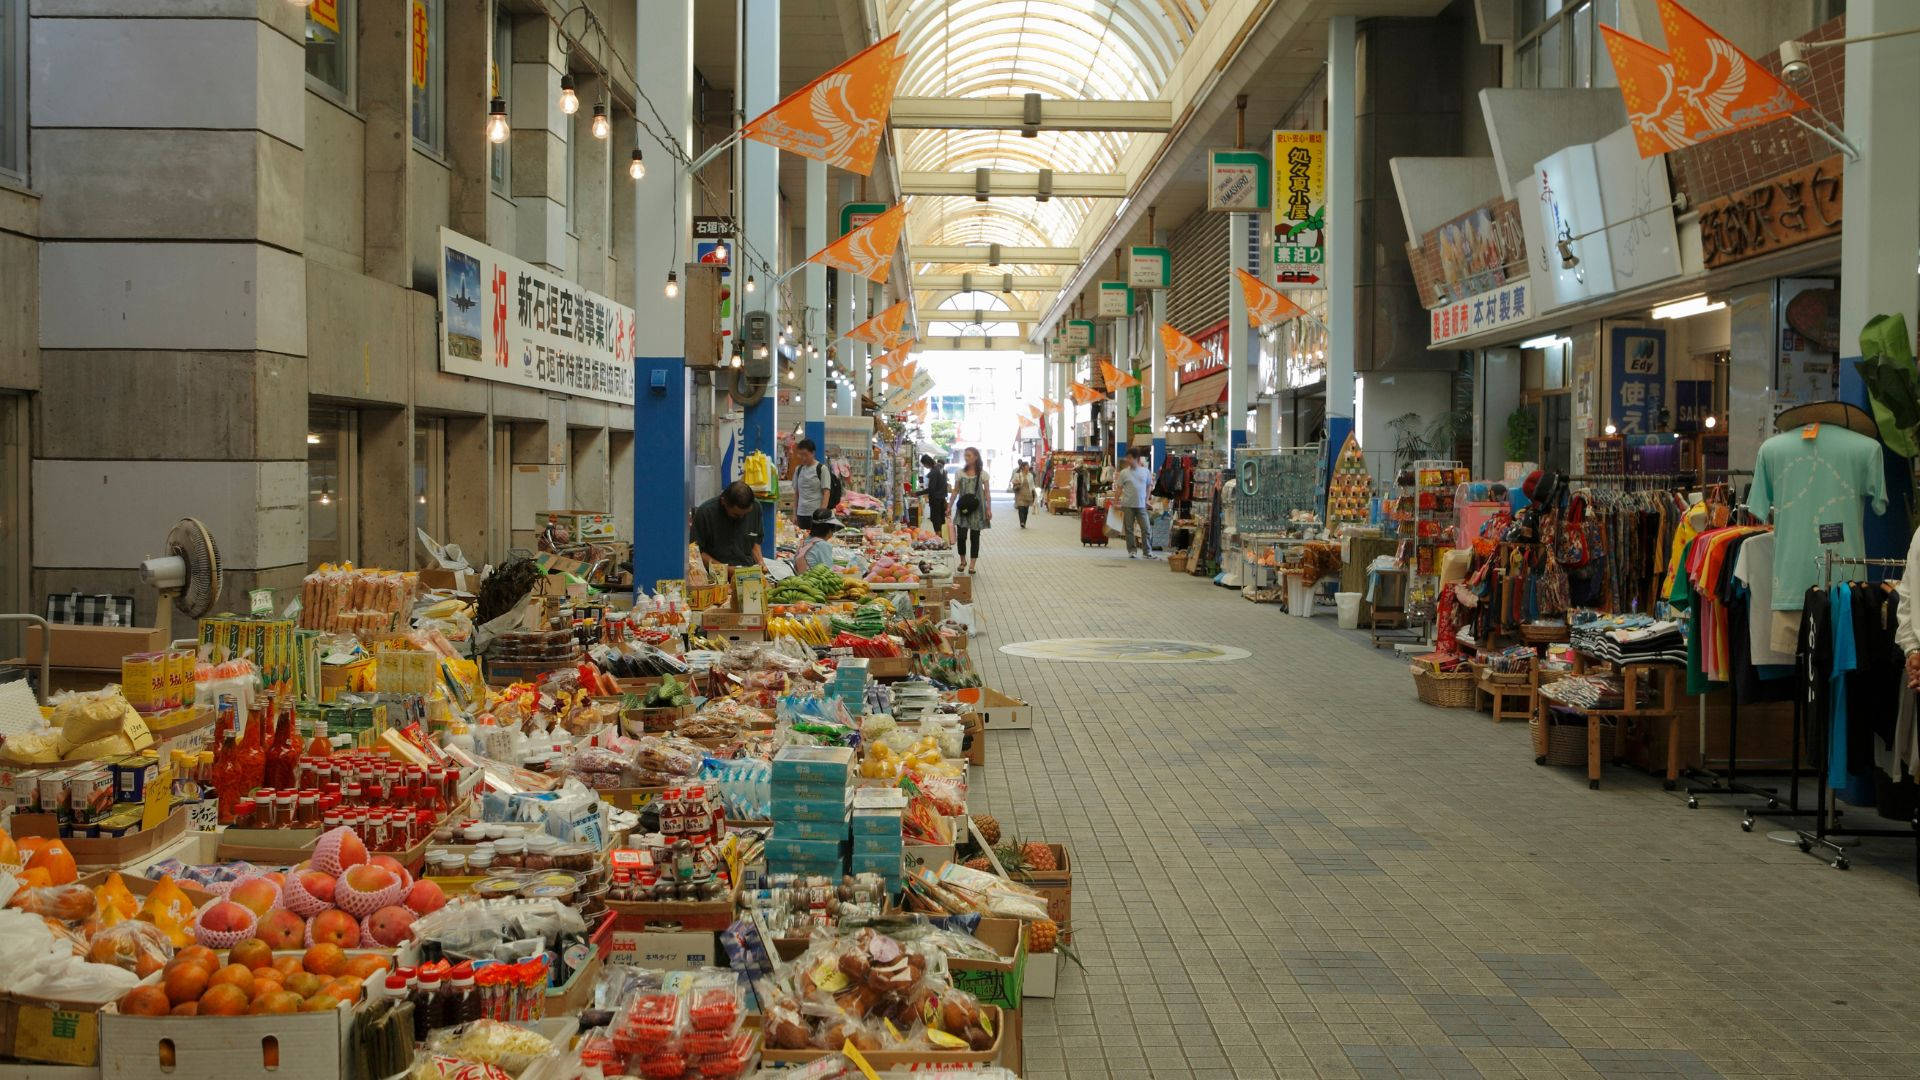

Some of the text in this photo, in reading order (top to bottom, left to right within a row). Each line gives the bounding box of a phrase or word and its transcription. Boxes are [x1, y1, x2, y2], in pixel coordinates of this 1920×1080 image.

[1277, 247, 1321, 263] 素泊り
[492, 263, 509, 368] 祝
[1433, 286, 1525, 340] 製造販売 本村製菓
[1631, 359, 1653, 372] Edy
[645, 953, 677, 961] 本格タイプ
